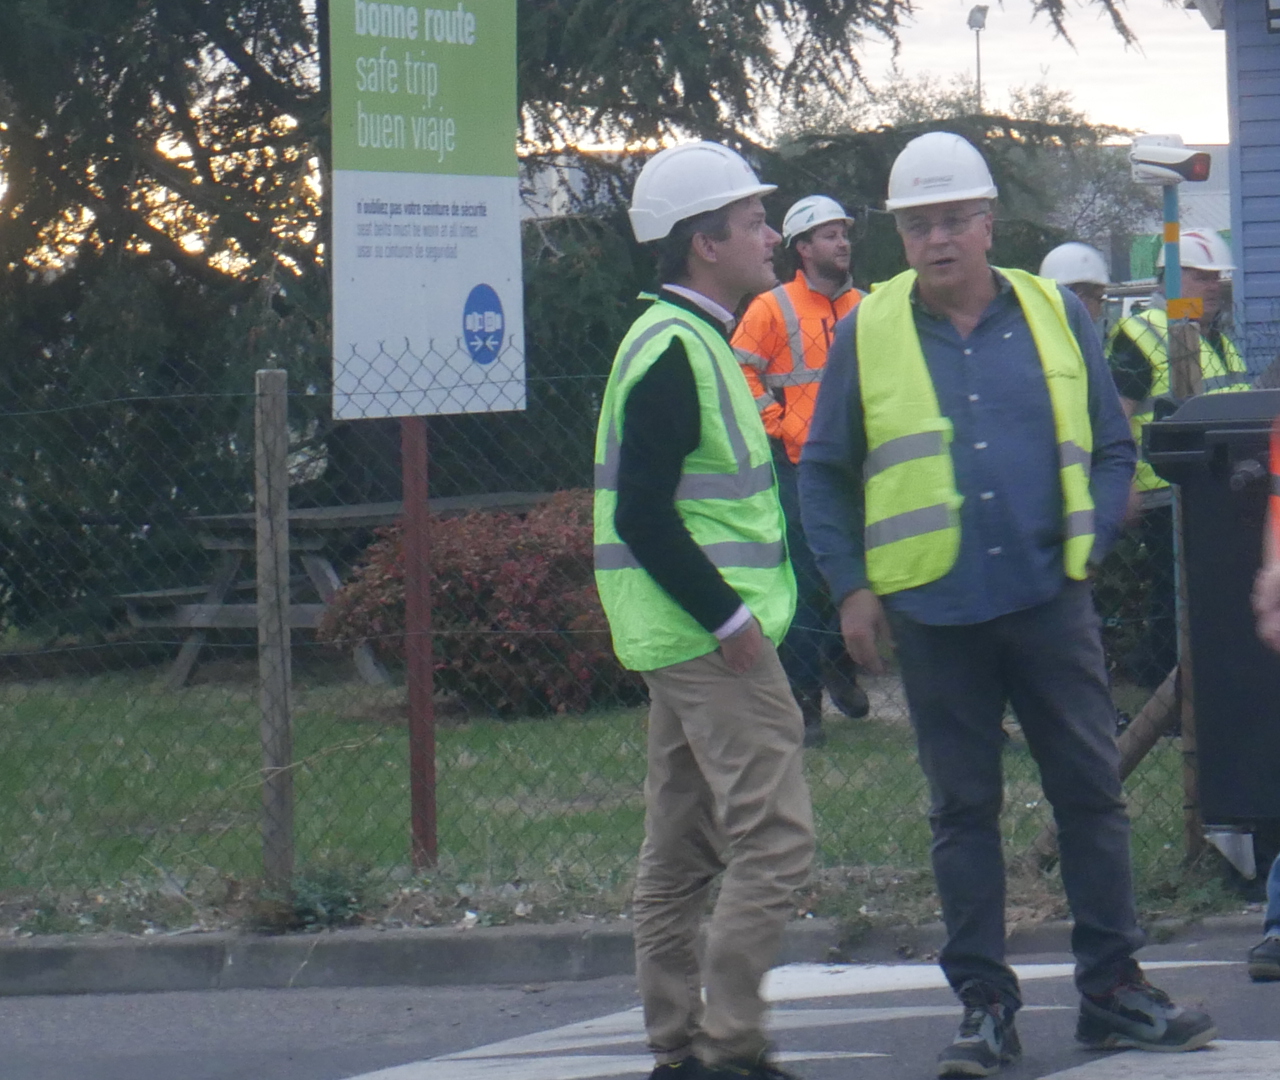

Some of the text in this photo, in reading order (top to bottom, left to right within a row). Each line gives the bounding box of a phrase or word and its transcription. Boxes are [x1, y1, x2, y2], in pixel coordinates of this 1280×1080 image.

[424, 1, 477, 46] route
[356, 45, 439, 109] safe trip
[357, 99, 457, 164] buen viaje
